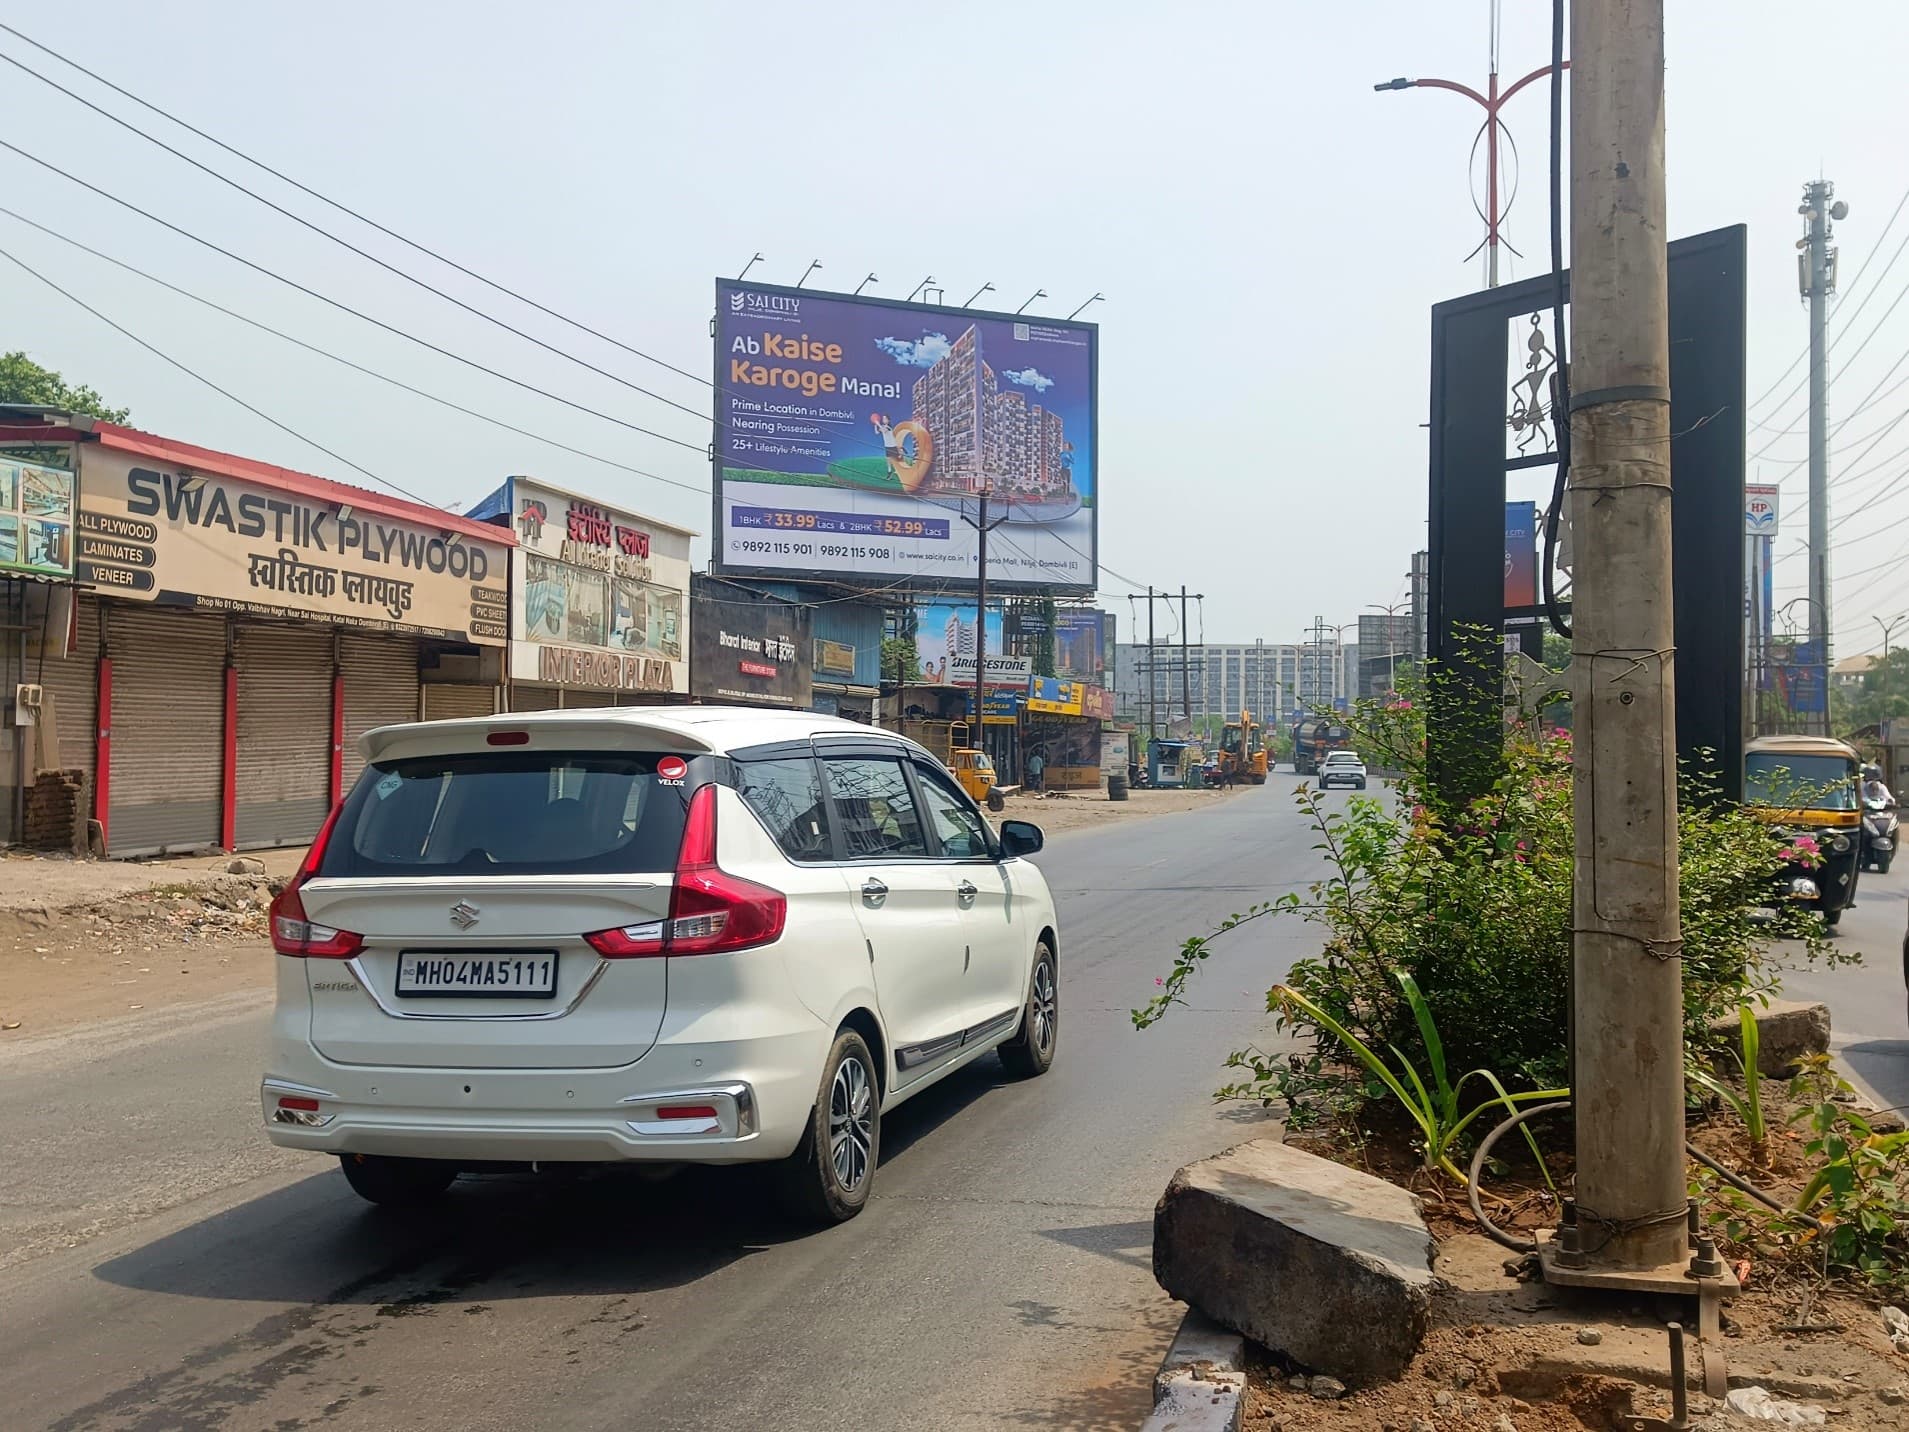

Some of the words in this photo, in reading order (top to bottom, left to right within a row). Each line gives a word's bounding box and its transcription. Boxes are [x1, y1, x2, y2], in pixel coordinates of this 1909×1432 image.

[747, 293, 768, 308] SAI
[772, 296, 800, 312] CITY
[732, 335, 760, 354] Ab
[763, 332, 842, 363] Kaise
[731, 359, 836, 397] Karoge
[841, 376, 901, 398] Mana!
[732, 398, 761, 411] Prime
[764, 401, 808, 415] Location
[809, 407, 818, 416] in
[819, 408, 855, 419] Dombivli
[732, 417, 775, 433] Nearing
[777, 423, 820, 434] Possession
[732, 439, 753, 450] 25+
[755, 442, 788, 455] Lifestyle
[790, 446, 831, 457] Amenities
[1752, 503, 1767, 512] HP
[79, 513, 98, 530] ALL
[100, 518, 152, 539] PLYWOOD
[127, 467, 328, 552] SWASTIK
[338, 518, 488, 582] PLYWOOD
[739, 515, 762, 525] 1BHK
[817, 521, 835, 530] Lacs
[839, 522, 846, 530] &
[850, 522, 873, 532] 2BHK
[925, 528, 942, 536] Lacs
[83, 540, 143, 562] LAMINATES
[742, 540, 771, 553] 9892
[774, 543, 790, 554] 115
[793, 543, 812, 555] 901
[820, 545, 849, 557] 9892
[850, 547, 866, 558] 115
[868, 547, 890, 559] 908
[92, 566, 134, 585] VENEER
[248, 547, 338, 598] स्वस्तिक
[342, 570, 414, 620] प्लायवुड
[196, 596, 214, 608] Shop
[215, 599, 224, 608] No
[232, 602, 247, 612] Opp.
[247, 603, 270, 614] Vaibhav
[287, 608, 300, 618] Near
[300, 609, 310, 619] Sai
[476, 607, 488, 617] PVC
[475, 623, 493, 635] FLUSH
[720, 630, 739, 649] Bharat
[740, 634, 761, 653] Interior
[539, 645, 621, 688] INTERIOR
[622, 656, 674, 691] PLAZA
[657, 778, 686, 787] VELOX
[415, 960, 550, 985] MH04MA5111
